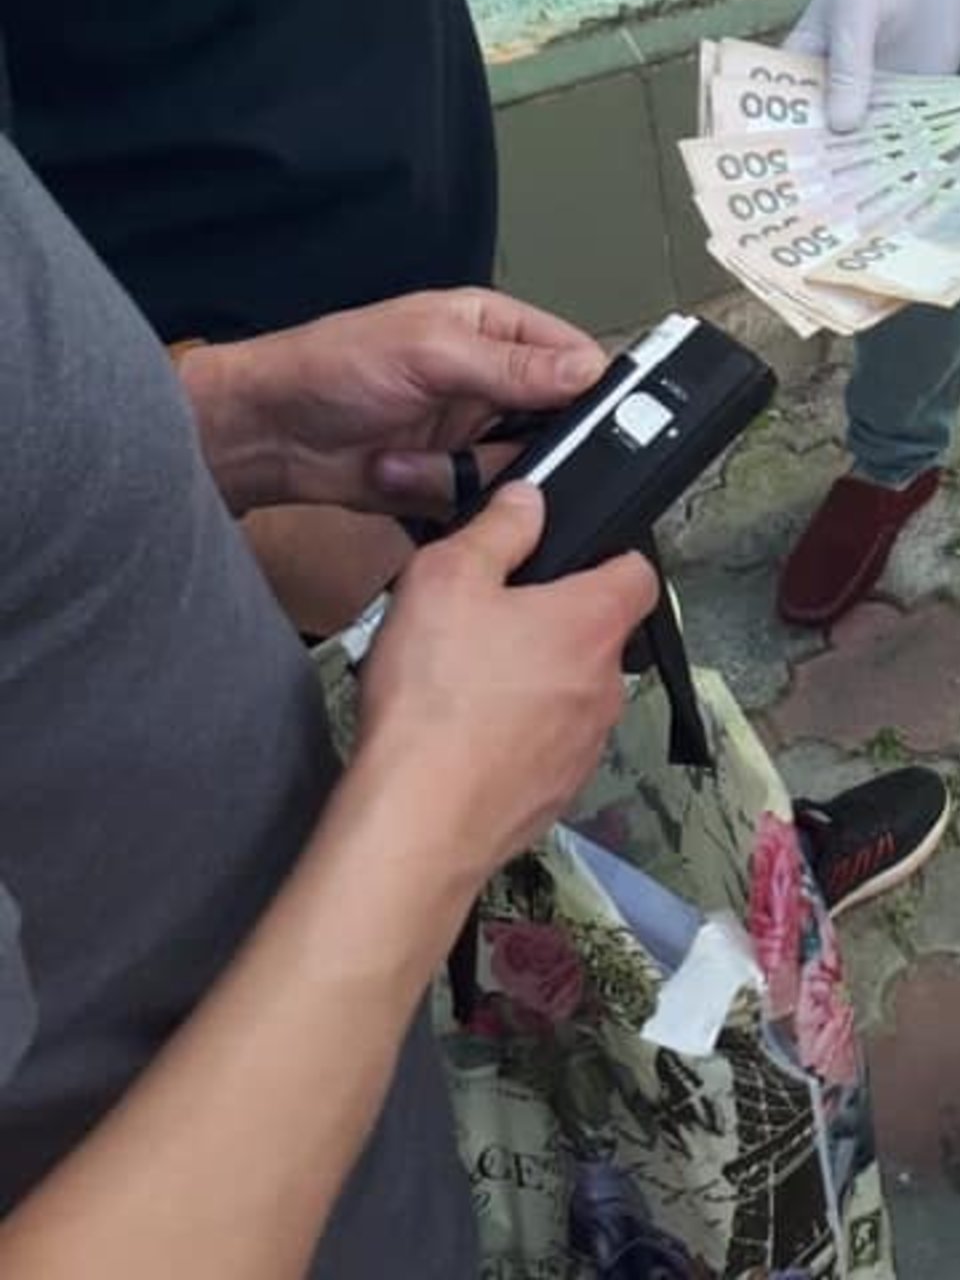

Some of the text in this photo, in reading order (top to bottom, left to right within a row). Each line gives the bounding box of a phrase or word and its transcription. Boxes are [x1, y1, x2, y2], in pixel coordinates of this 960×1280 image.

[740, 91, 809, 124] 500
[717, 149, 788, 180] 500
[728, 182, 798, 220] 500
[771, 225, 839, 267] 500
